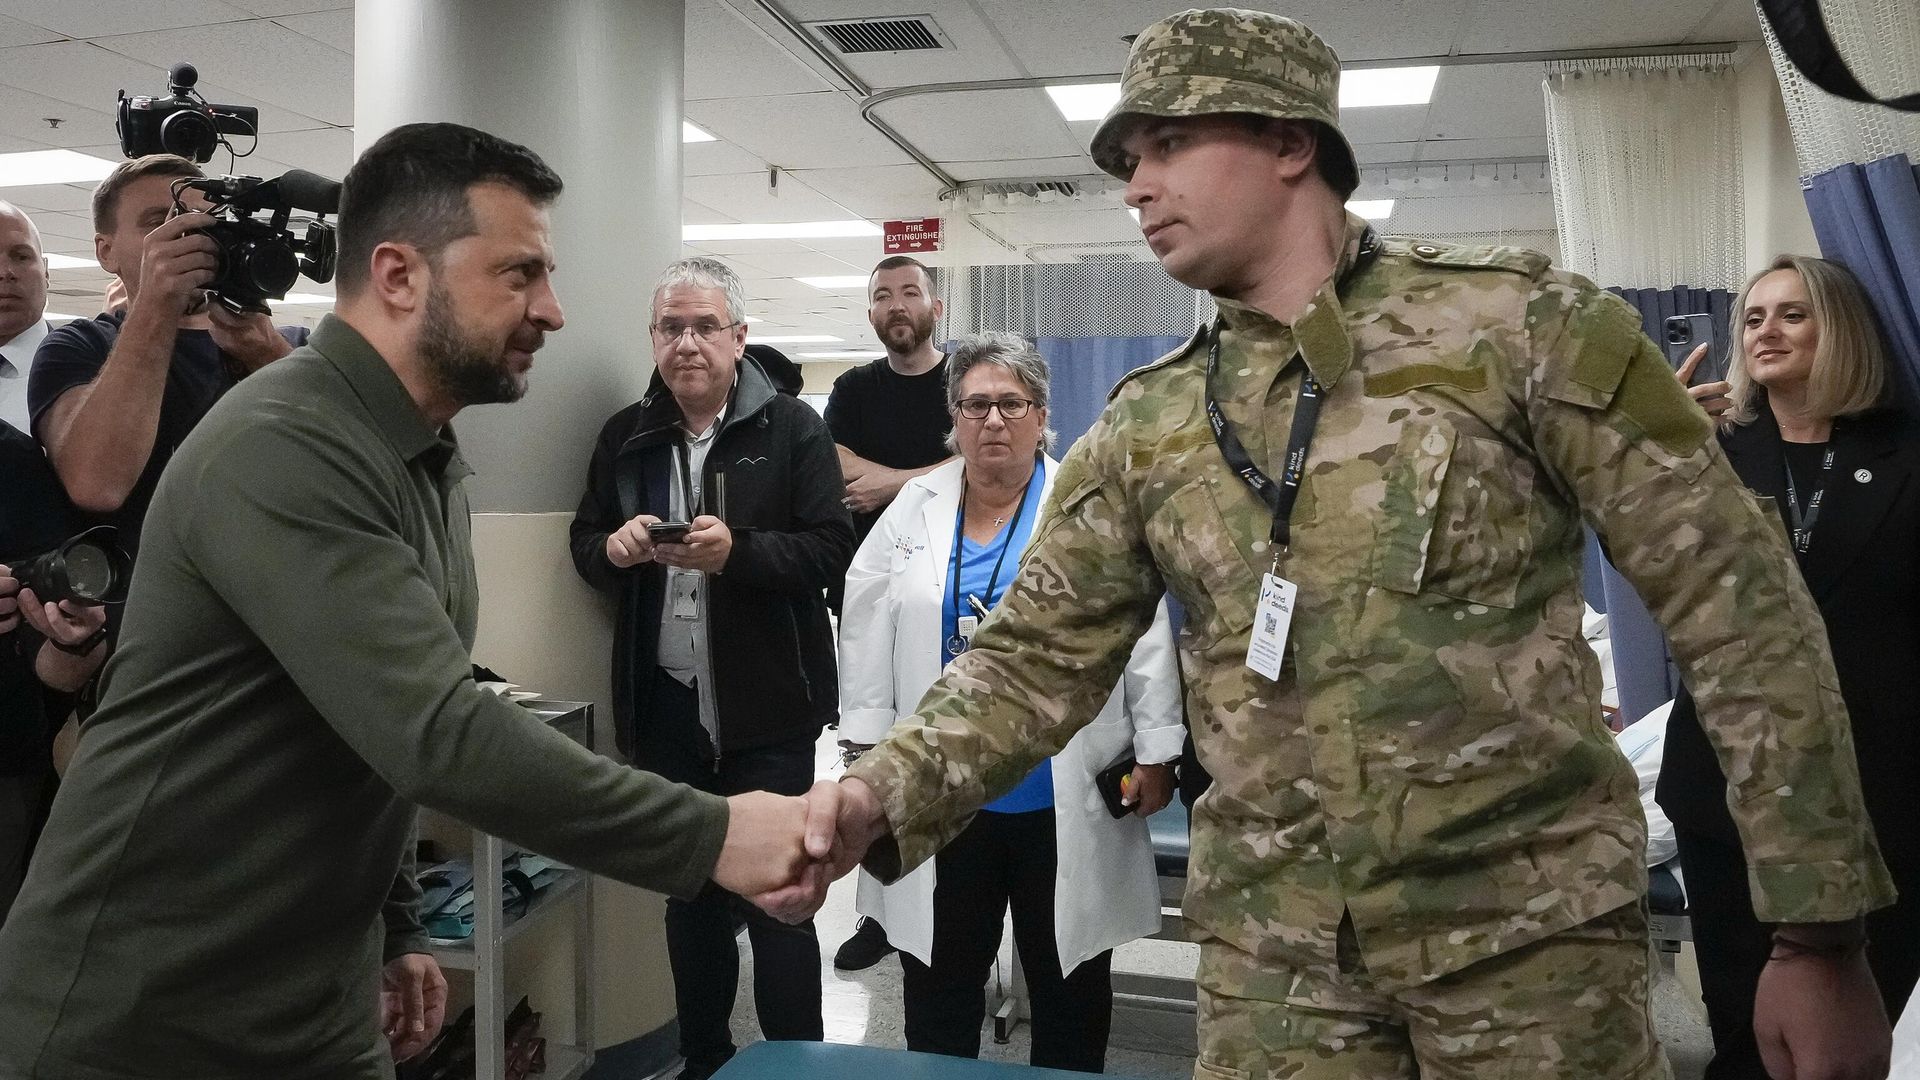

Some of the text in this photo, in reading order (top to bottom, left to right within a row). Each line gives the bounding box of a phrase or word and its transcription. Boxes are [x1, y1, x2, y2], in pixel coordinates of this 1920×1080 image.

[905, 224, 924, 232] FIRE
[886, 232, 941, 241] EXTINGUISHE
[1288, 452, 1297, 470] kind
[1859, 471, 1868, 480] R
[1272, 592, 1286, 603] kind
